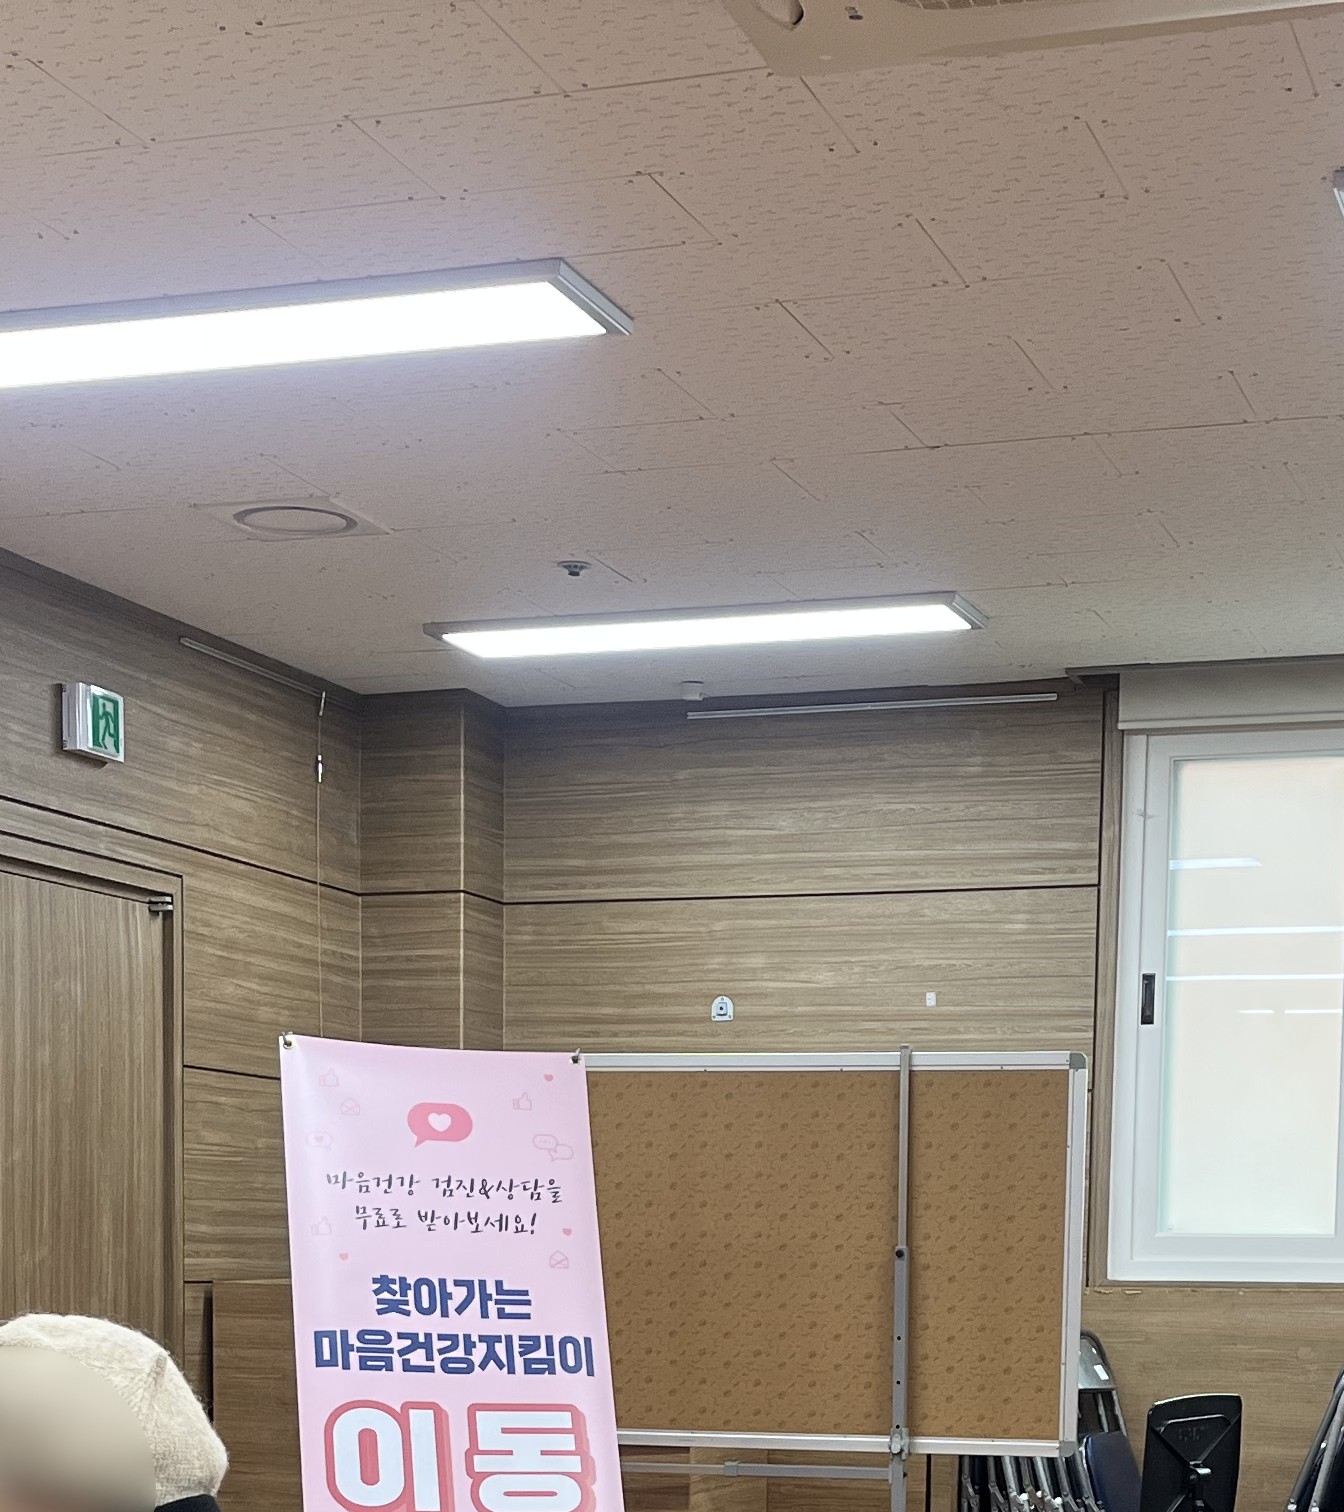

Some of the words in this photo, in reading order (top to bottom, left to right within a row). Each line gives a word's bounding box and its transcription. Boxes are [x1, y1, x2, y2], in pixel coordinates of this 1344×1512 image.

[326, 1171, 420, 1197] 마음건강
[432, 1174, 563, 1205] 검진&상담을
[355, 1205, 408, 1231] 무료로
[417, 1209, 538, 1236] 받아보세요!
[371, 1274, 533, 1320] 찾아가는
[313, 1328, 596, 1377] 마음건강지킴이
